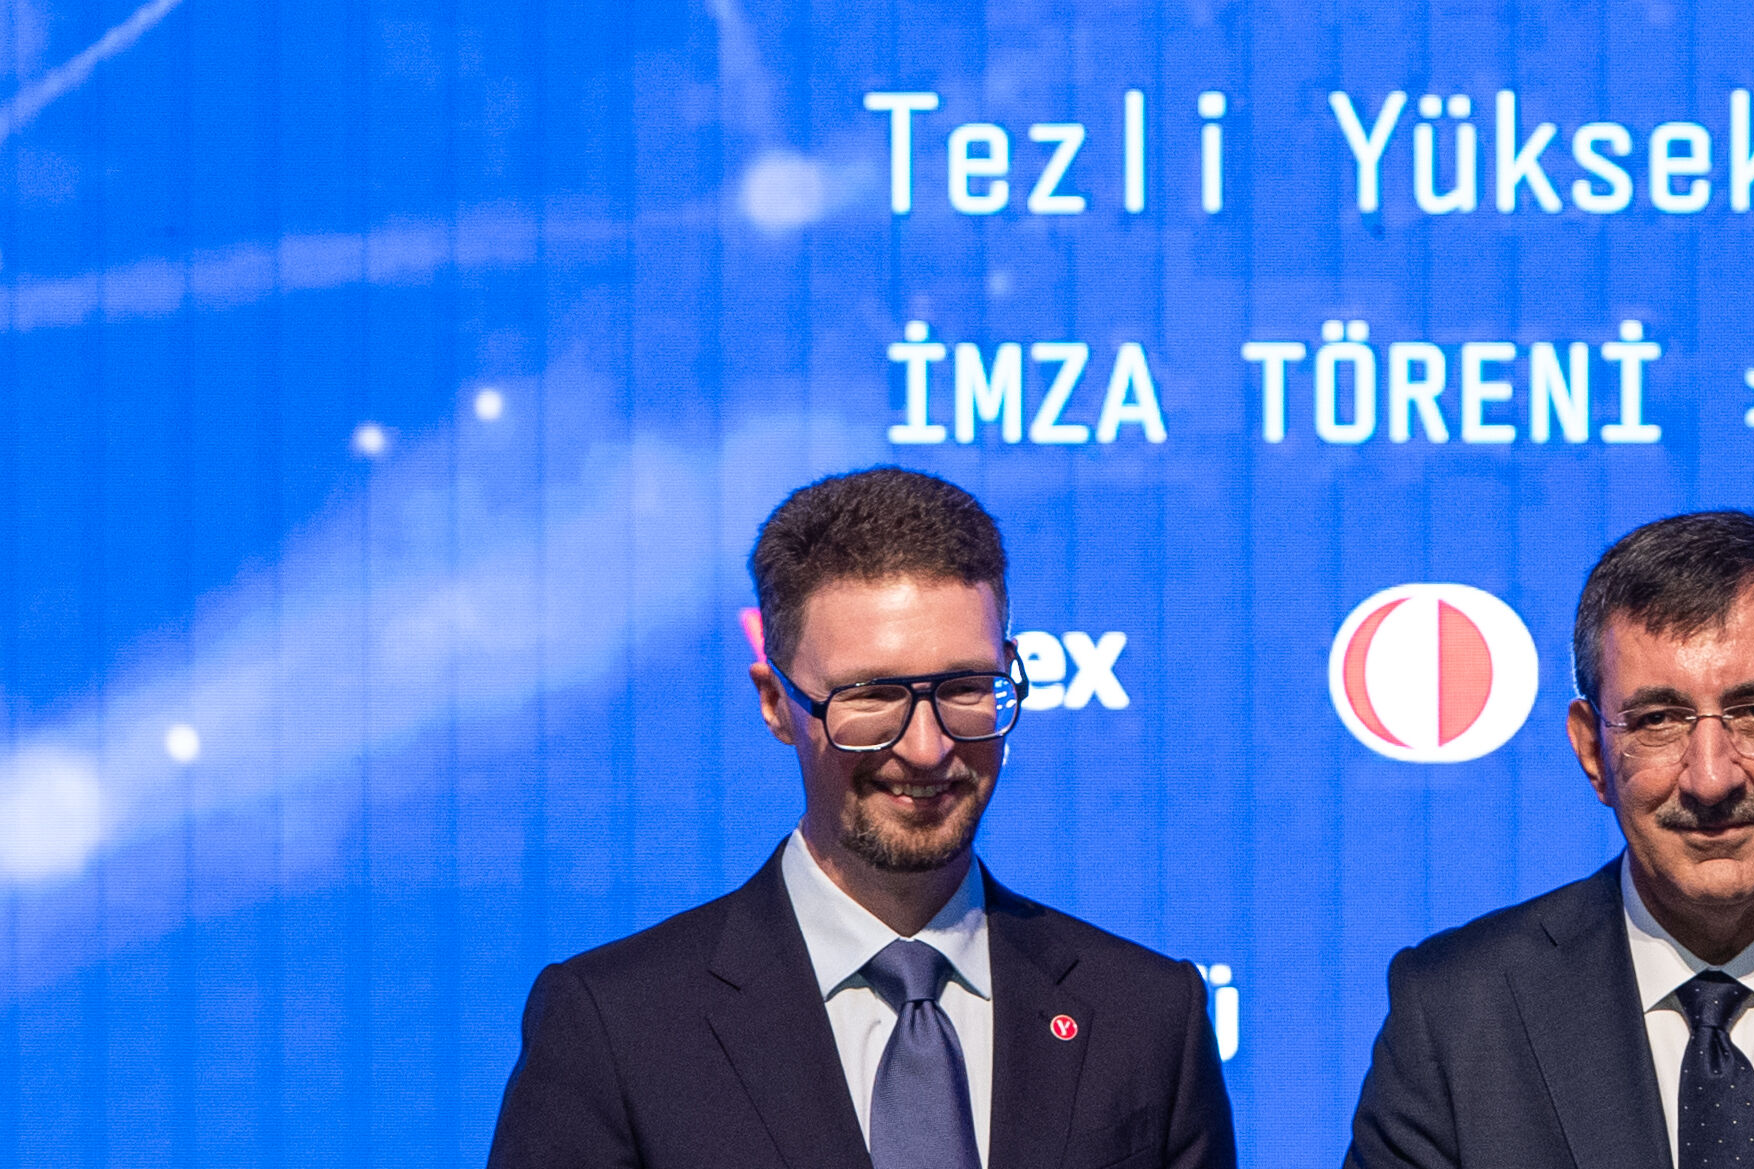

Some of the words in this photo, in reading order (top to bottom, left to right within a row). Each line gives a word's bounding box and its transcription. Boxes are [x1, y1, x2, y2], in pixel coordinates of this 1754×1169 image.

[864, 89, 1226, 215] Tezli
[887, 319, 1168, 445] İMZA
[1241, 318, 1662, 445] TÖRENİ
